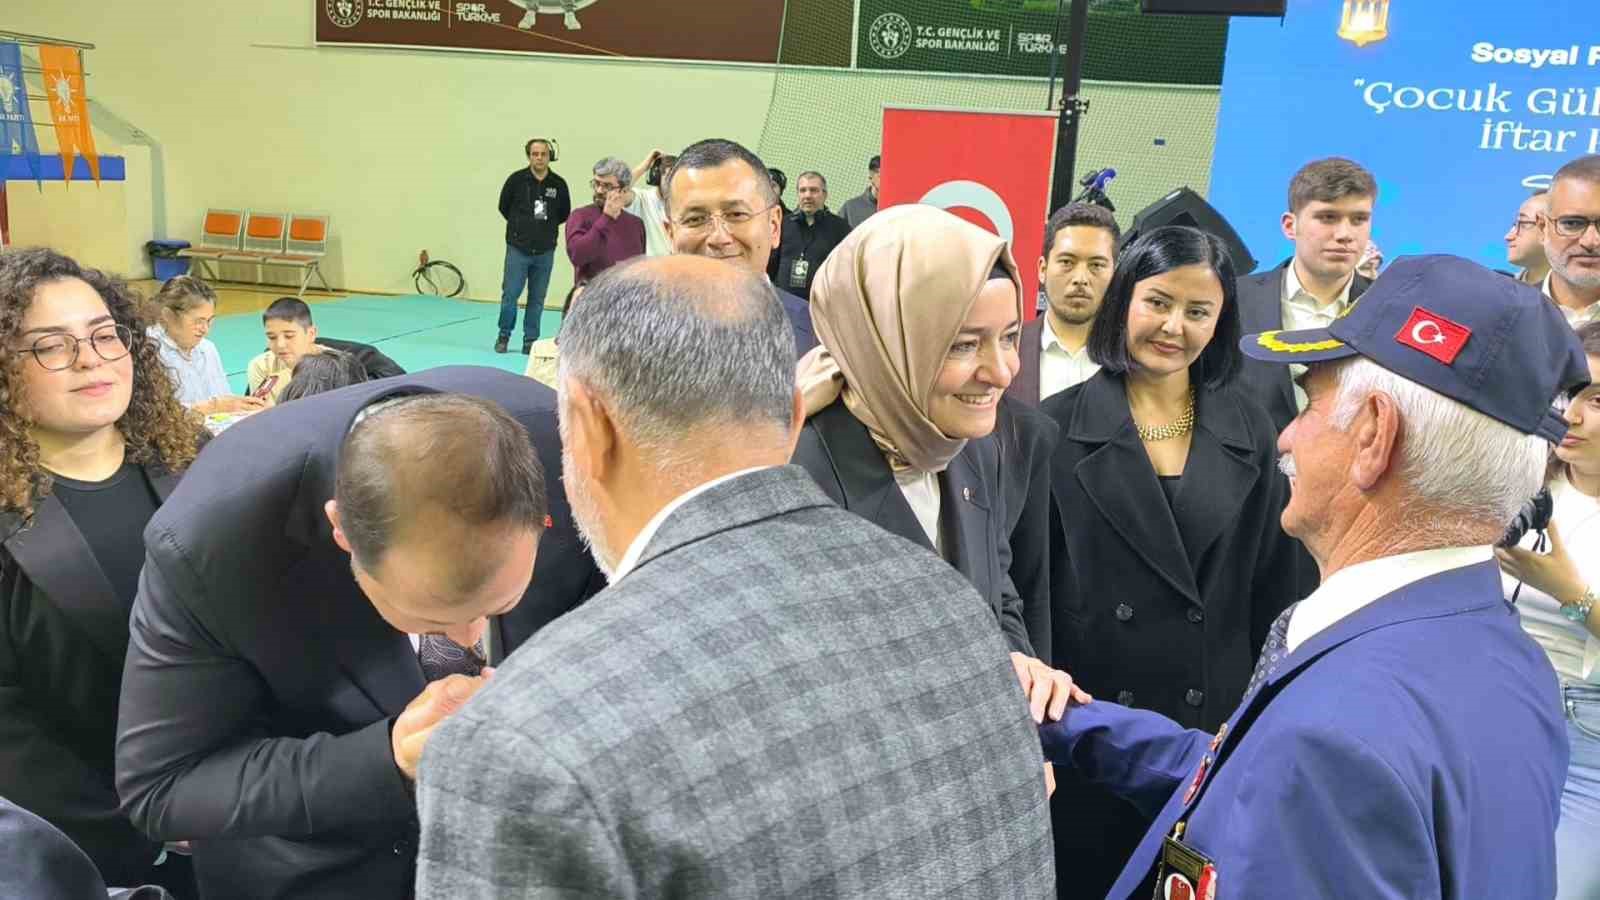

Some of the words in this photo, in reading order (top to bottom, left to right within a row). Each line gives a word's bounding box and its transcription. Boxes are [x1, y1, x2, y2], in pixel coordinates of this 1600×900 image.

[428, 0, 441, 9] VE
[455, 2, 486, 12] SPOR
[367, 8, 391, 19] SPOR
[392, 9, 441, 21] BAKANLIĞI
[916, 26, 936, 37] T.C.
[937, 26, 984, 40] GENÇLİK
[986, 29, 1001, 40] VE
[915, 38, 943, 49] SPOR
[944, 39, 1000, 52] BAKANLIĞI
[1471, 41, 1580, 69] Sosyal
[1354, 78, 1513, 114] "Çocuk
[1478, 118, 1577, 153] İftar
